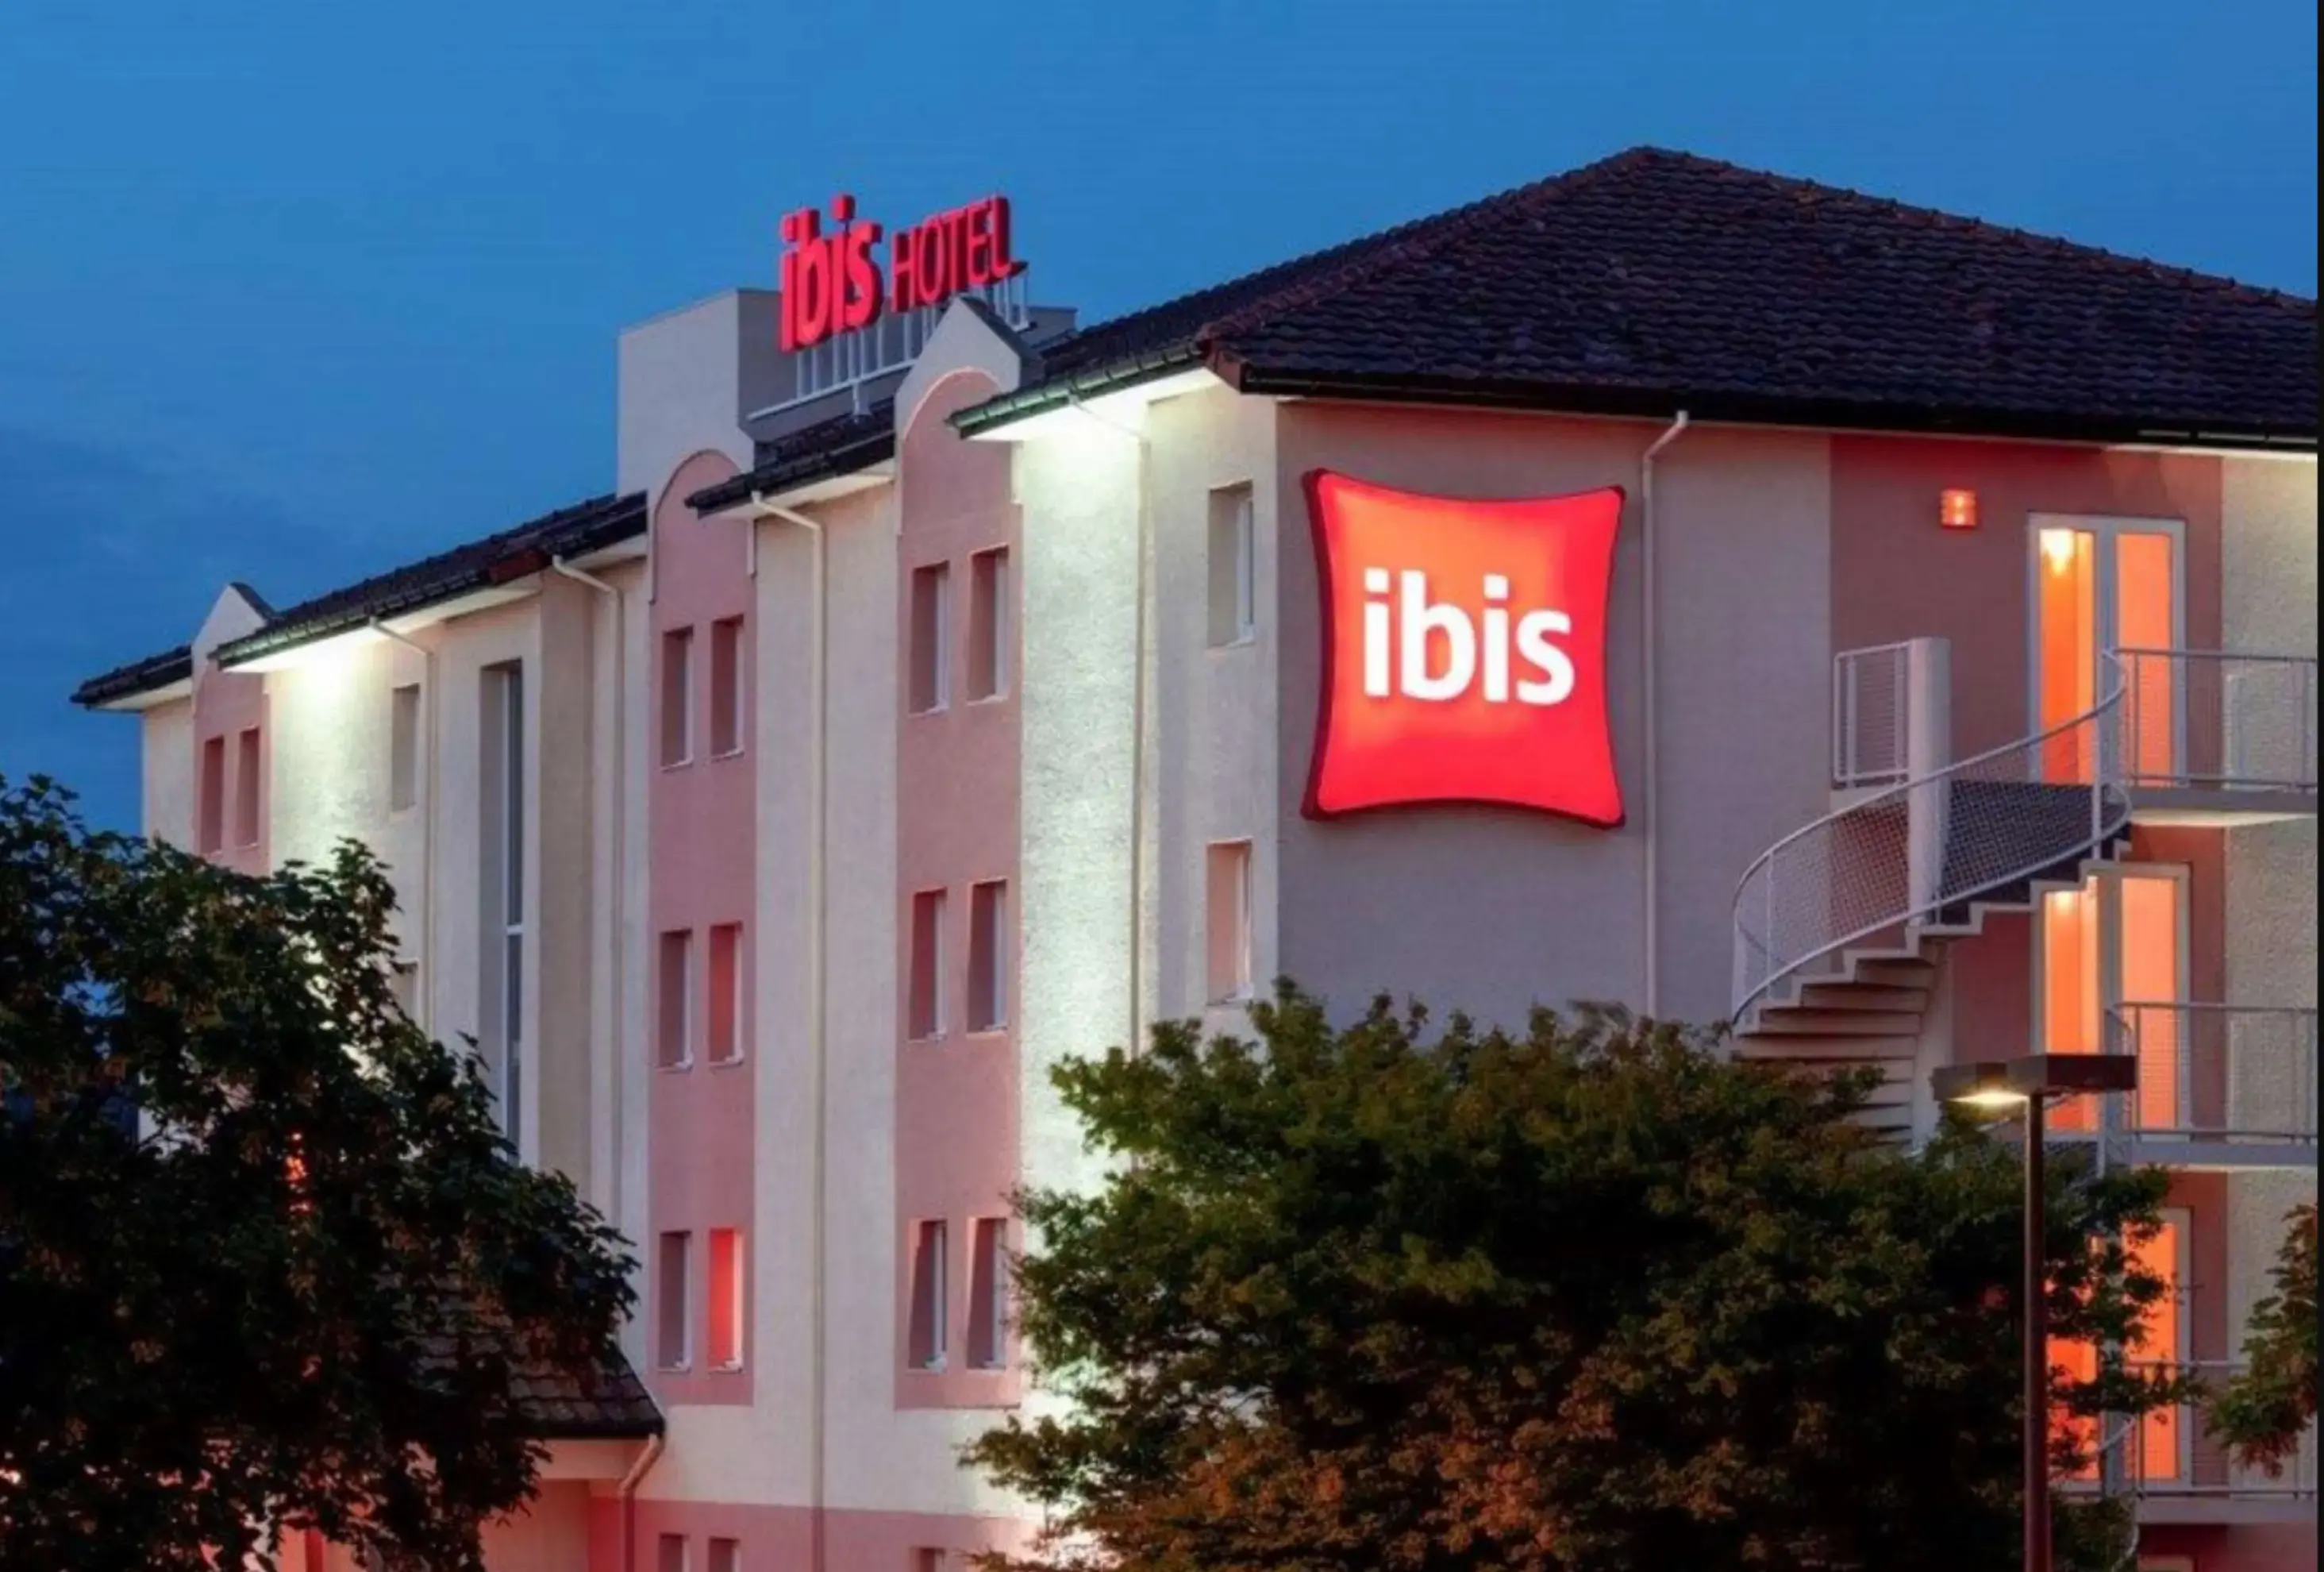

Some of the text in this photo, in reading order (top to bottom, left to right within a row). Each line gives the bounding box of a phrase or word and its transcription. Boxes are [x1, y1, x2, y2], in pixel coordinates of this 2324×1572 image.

[780, 195, 1027, 353] ibis HOTEL
[1364, 568, 1576, 706] ibis
